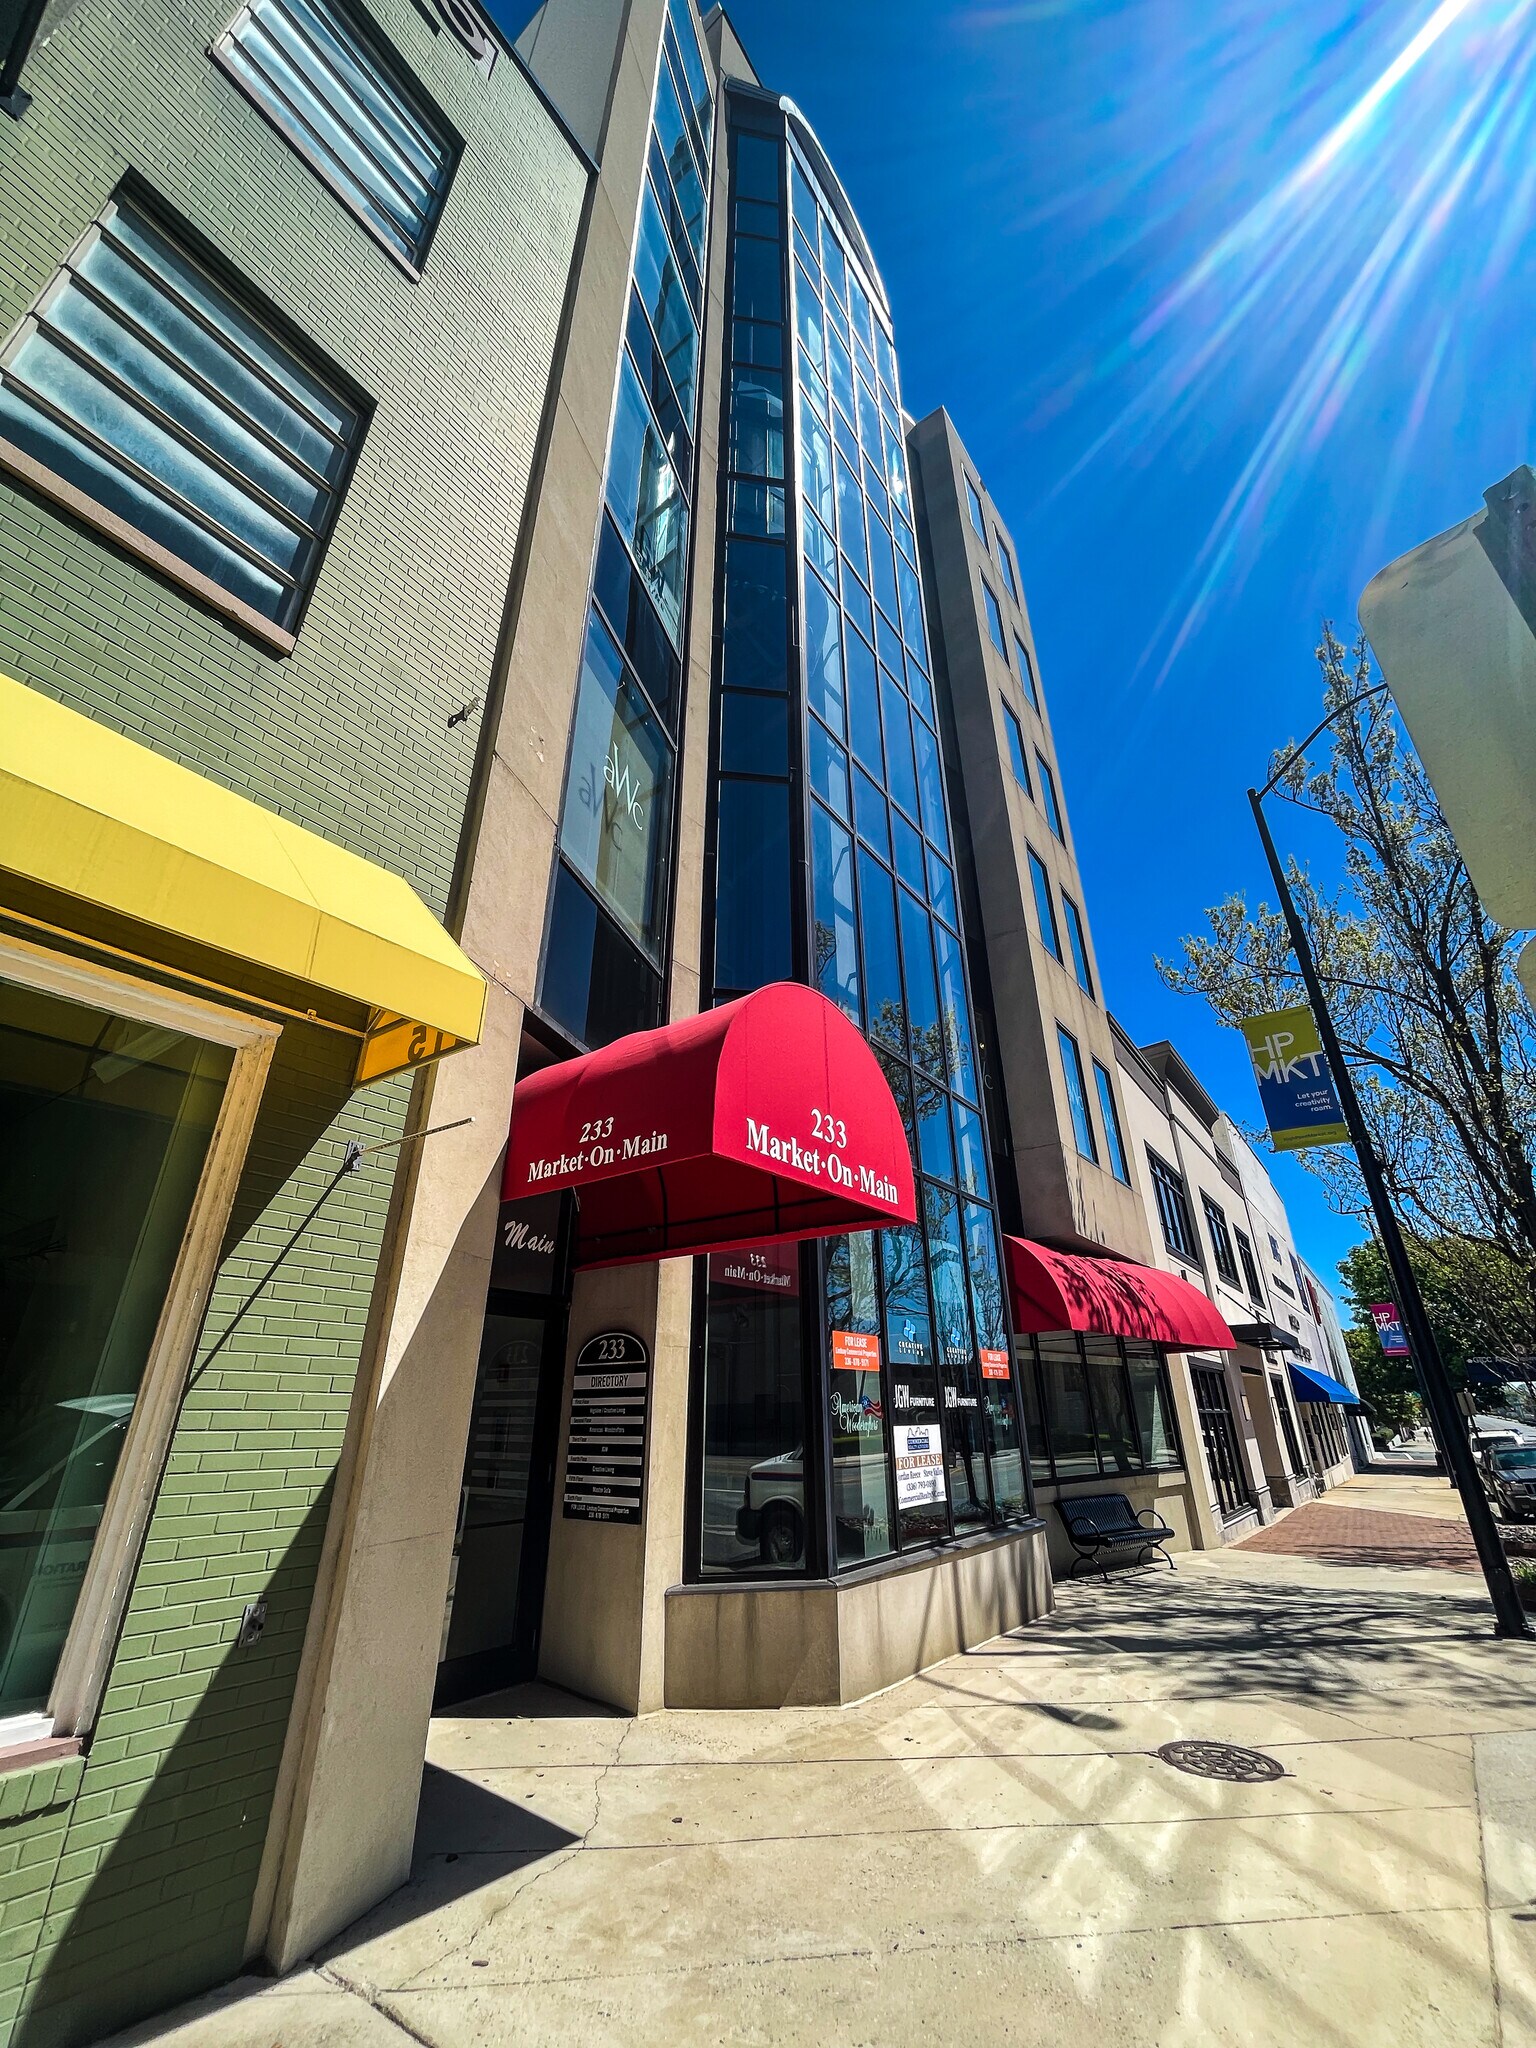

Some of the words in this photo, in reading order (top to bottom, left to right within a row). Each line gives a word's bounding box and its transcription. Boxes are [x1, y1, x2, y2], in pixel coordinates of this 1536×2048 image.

[1247, 1032, 1295, 1062] HP
[1253, 1050, 1324, 1087] MKT
[1294, 1097, 1331, 1108] creativity
[1297, 1091, 1310, 1100] Let
[1311, 1089, 1328, 1098] your
[579, 1116, 614, 1143] 233
[811, 1108, 847, 1149] 233
[504, 1220, 555, 1254] Main
[1372, 1312, 1390, 1323] HP
[1375, 1320, 1400, 1332] MKT
[598, 1338, 625, 1360] 233
[844, 1335, 854, 1346] FOR
[854, 1336, 868, 1348] LEASE
[591, 1375, 629, 1388] DIRECTORY
[830, 1391, 863, 1415] American
[894, 1384, 910, 1408] JGW
[909, 1397, 935, 1407] FURNITURE
[944, 1386, 957, 1408] JGW
[957, 1397, 978, 1406] FURNITURE
[898, 1457, 915, 1470] FOR
[916, 1454, 941, 1467] LEASE
